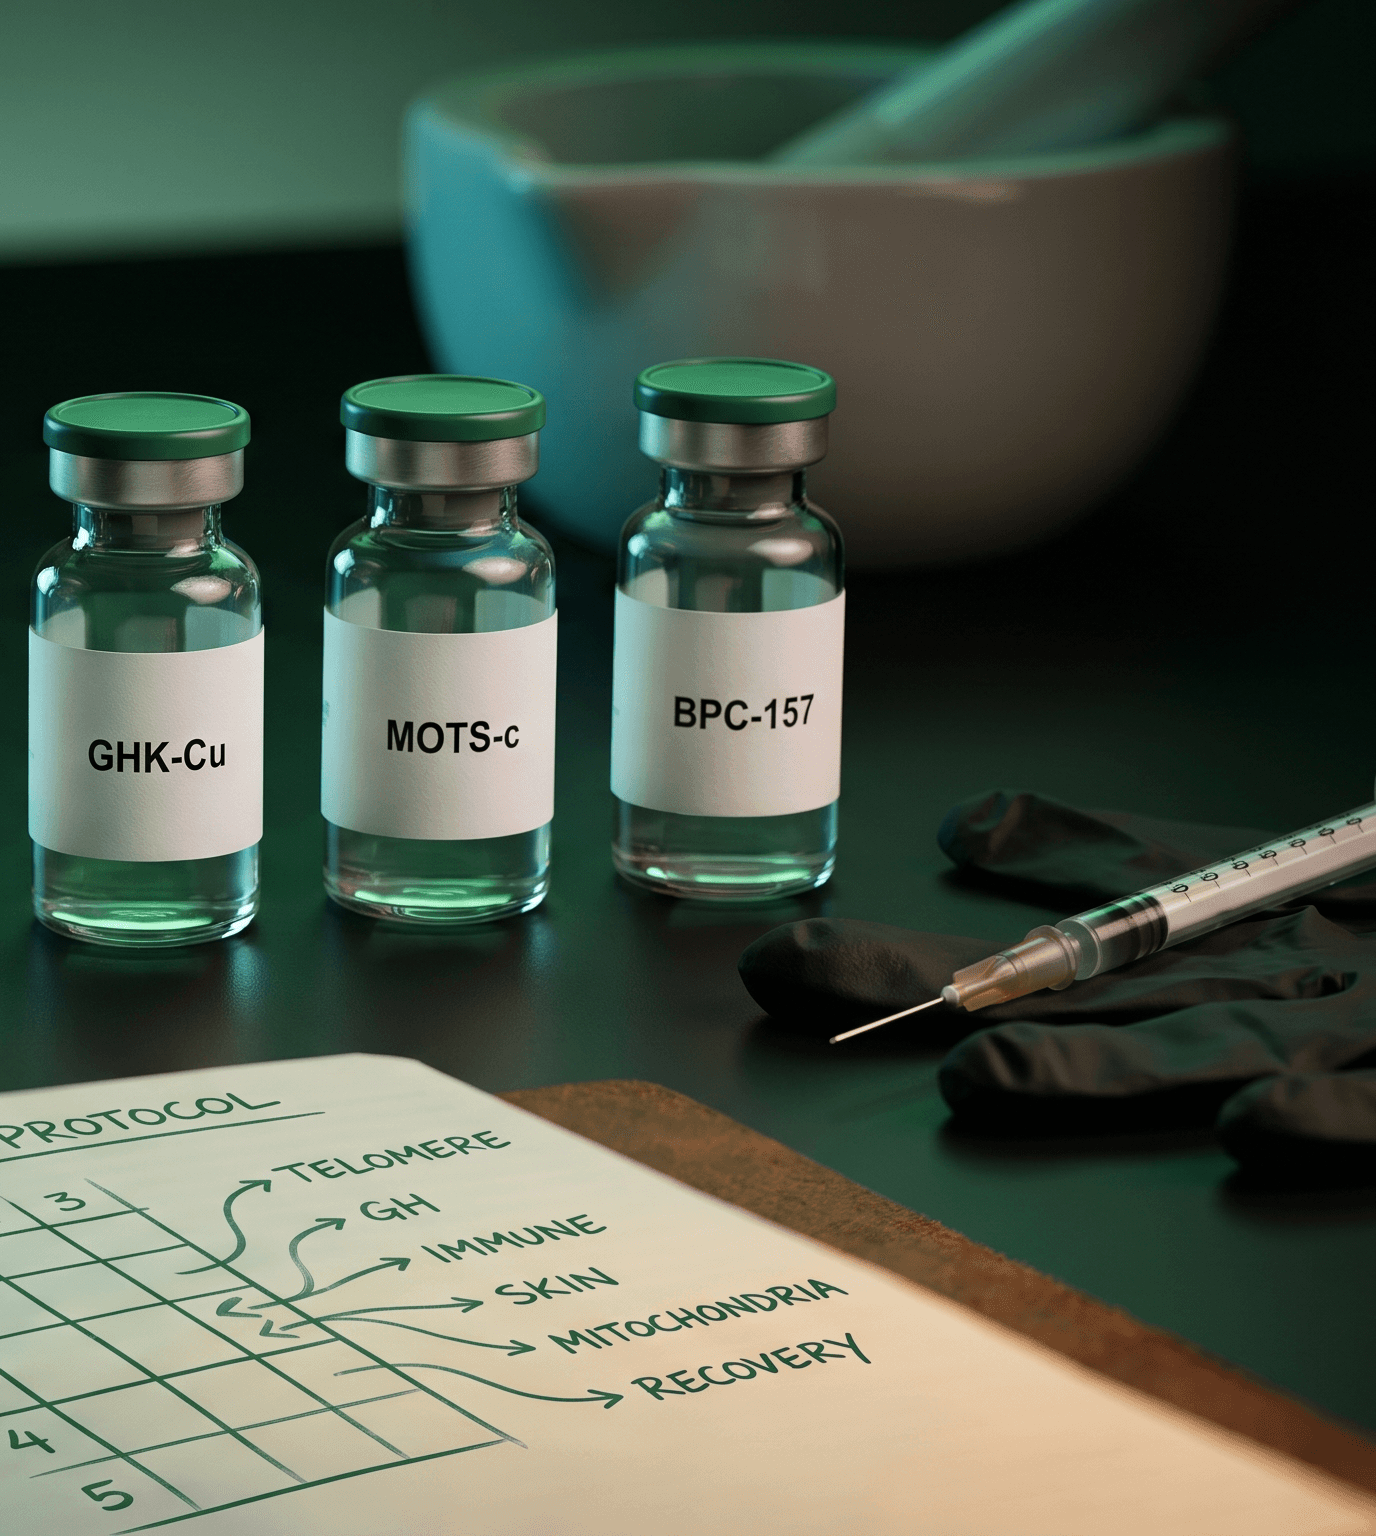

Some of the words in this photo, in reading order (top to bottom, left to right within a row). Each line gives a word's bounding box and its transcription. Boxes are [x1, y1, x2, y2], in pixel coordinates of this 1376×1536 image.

[672, 692, 815, 732] BPC-157
[386, 717, 520, 755] MOTS-c
[87, 737, 226, 775] GHK-Cu
[269, 1129, 513, 1184] TELOMERE
[42, 1190, 88, 1213] 3
[358, 1192, 442, 1223] GH
[419, 1212, 609, 1265] IMMUNE
[493, 1265, 621, 1307] SKIN
[546, 1277, 851, 1356] MITOCHONDRIA
[629, 1331, 873, 1402] RECOVERY
[6, 1428, 57, 1455] 4
[79, 1477, 135, 1513] 5
